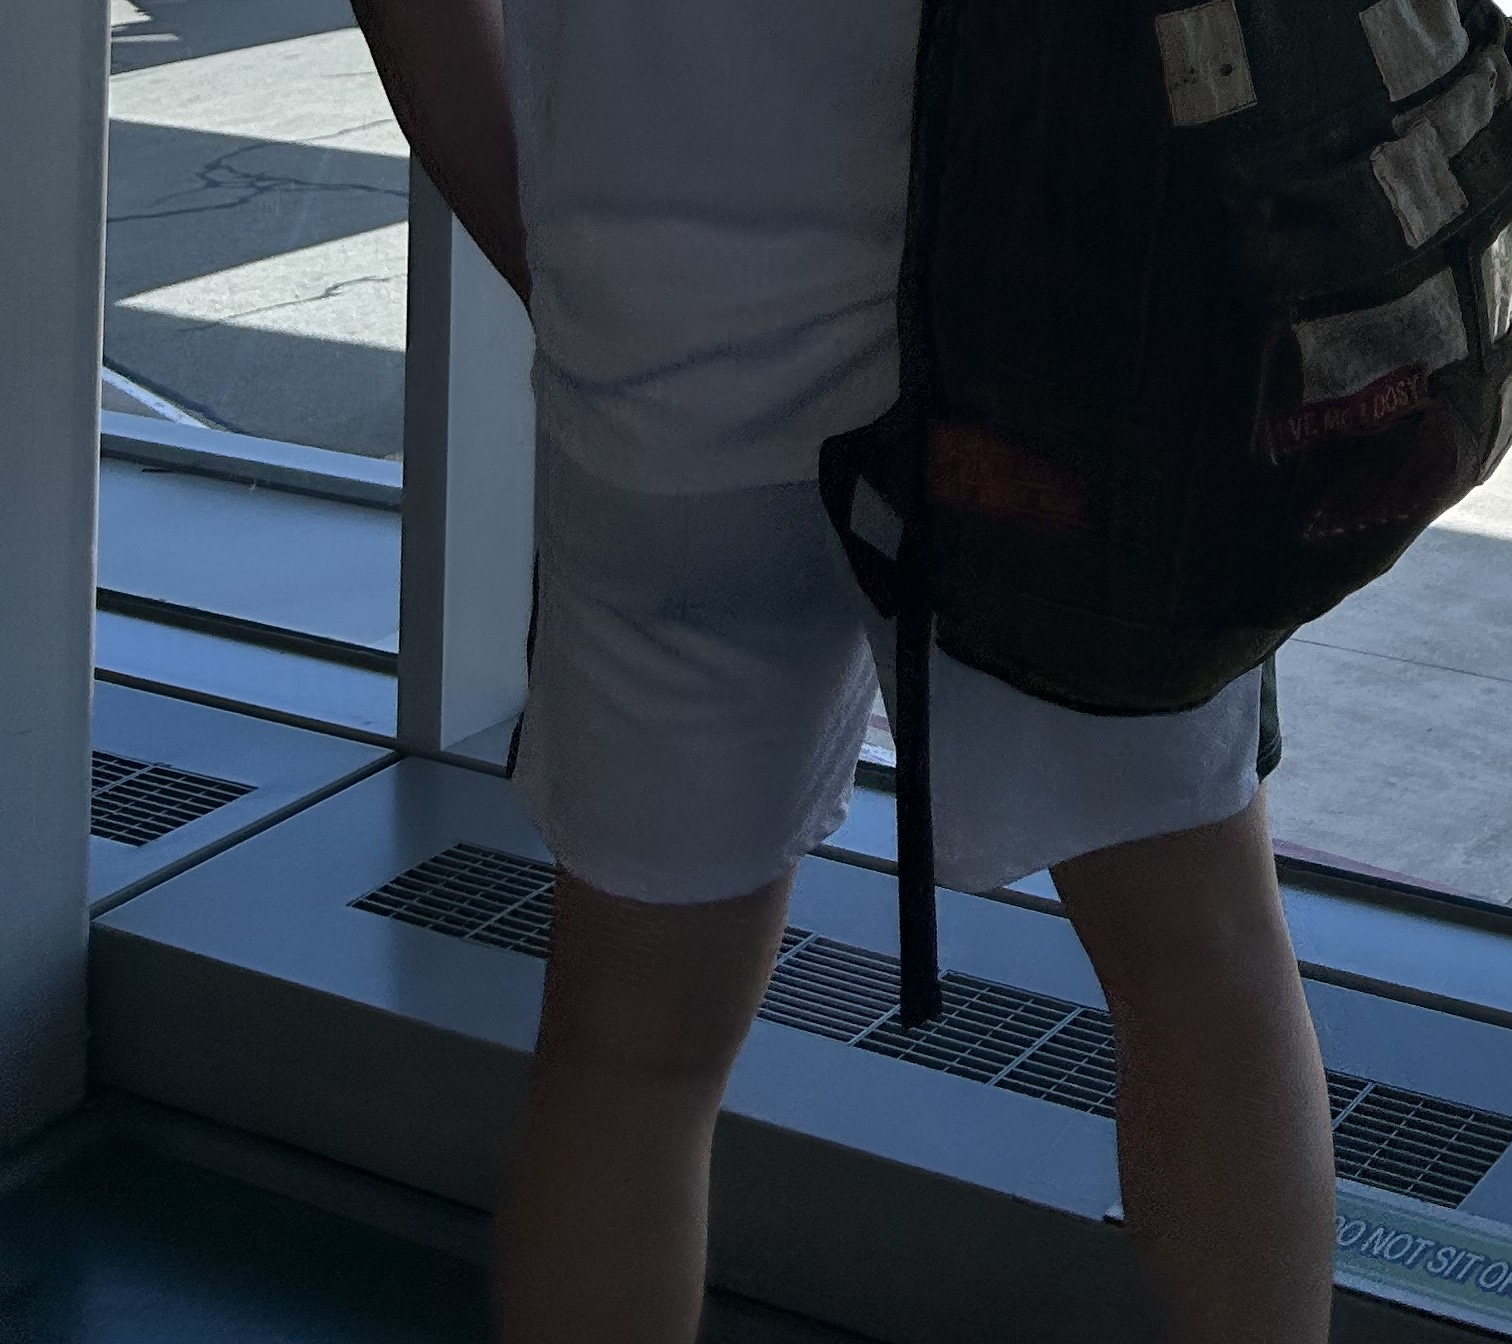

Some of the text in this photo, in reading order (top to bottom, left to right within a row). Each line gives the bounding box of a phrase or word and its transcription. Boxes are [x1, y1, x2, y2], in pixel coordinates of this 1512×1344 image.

[1335, 1215, 1367, 1247] O
[1360, 1227, 1435, 1266] NOT
[1426, 1246, 1485, 1281] SIT
